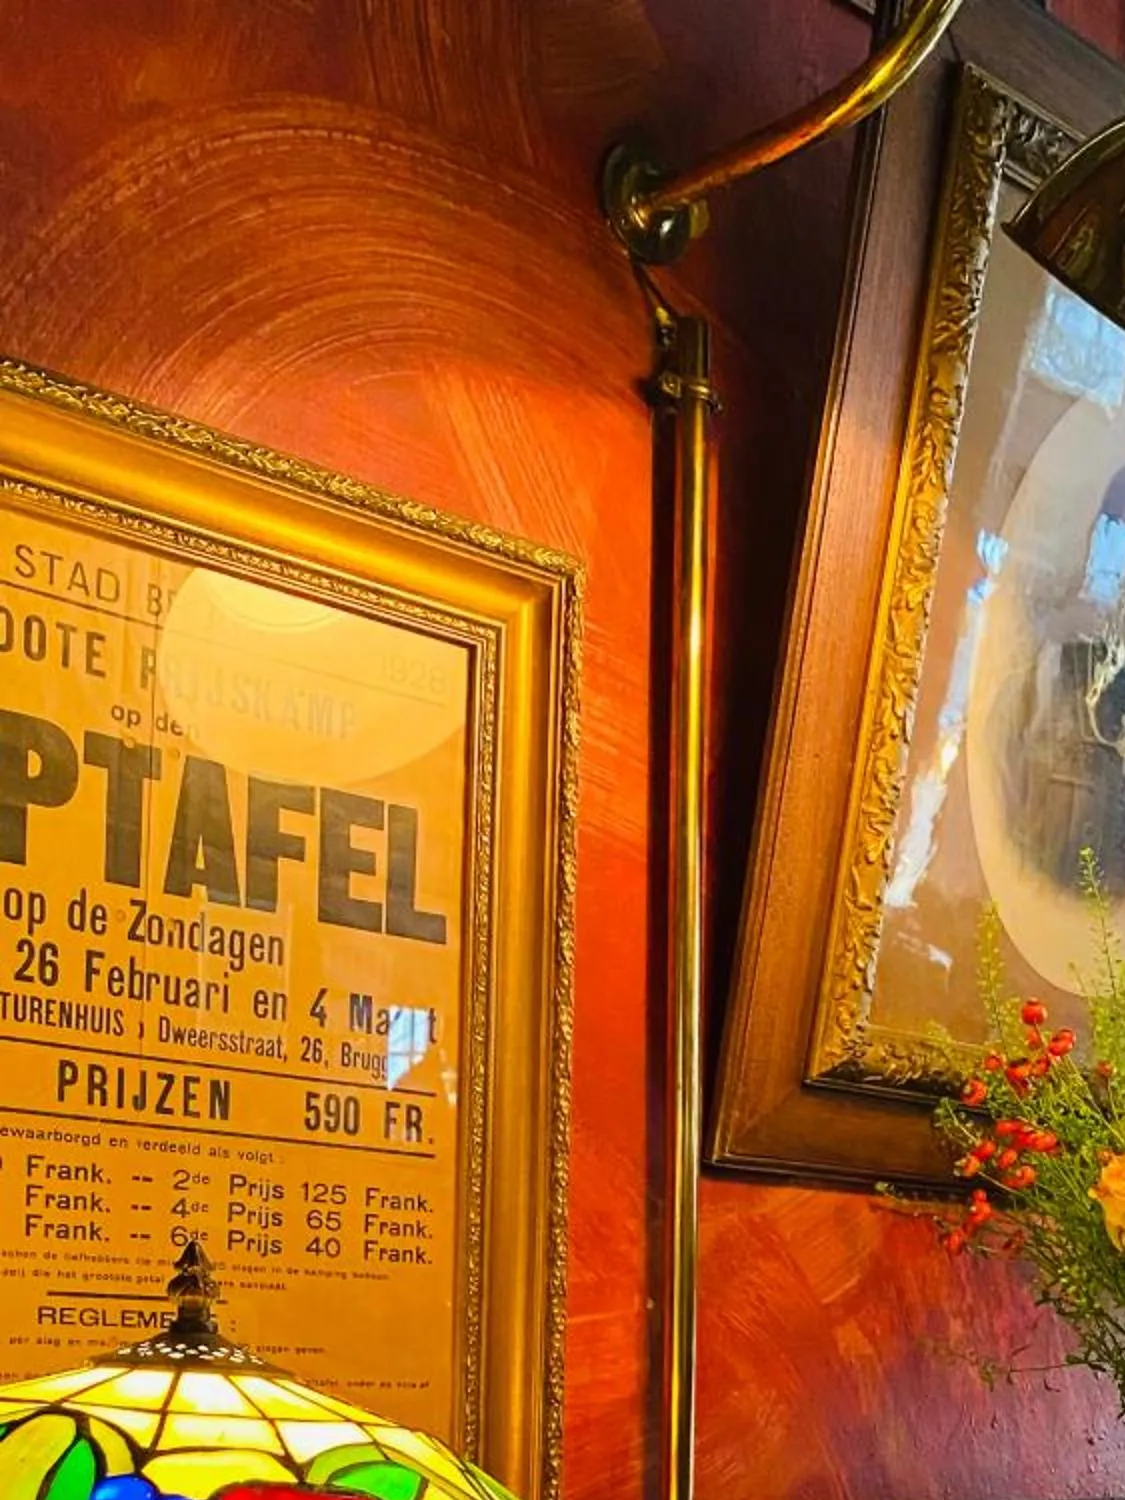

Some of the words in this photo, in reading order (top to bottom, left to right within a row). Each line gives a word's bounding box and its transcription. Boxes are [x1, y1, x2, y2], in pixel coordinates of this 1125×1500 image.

[15, 544, 120, 603] STAD
[110, 704, 141, 729] op
[0, 708, 446, 945] PTAFEL
[3, 888, 46, 936] op
[67, 888, 108, 936] de
[127, 899, 284, 972] Zondagen
[14, 938, 59, 987] 26
[84, 949, 229, 1014] Februari
[253, 988, 288, 1022] en
[309, 987, 329, 1028] 4
[349, 992, 437, 1044] Mat
[0, 991, 125, 1037] TURENHUIS
[159, 1015, 287, 1064] Dweersstraat,
[57, 1059, 231, 1121] PRIJZEN
[304, 1090, 360, 1136] 590
[384, 1100, 435, 1145] FR.
[109, 1137, 129, 1149] en
[209, 1146, 230, 1159] als
[25, 1184, 111, 1213] Frank.
[227, 1201, 283, 1229] Prijs
[306, 1209, 342, 1232] 65
[364, 1213, 433, 1239] Frank.
[26, 1154, 112, 1185] Frank.
[229, 1173, 285, 1202] Prijs
[301, 1181, 347, 1205] 125
[365, 1187, 434, 1213] Frank.
[25, 1213, 110, 1243] Frank.
[227, 1230, 282, 1257] Prijs
[305, 1236, 341, 1259] 40
[363, 1239, 433, 1265] Frank.
[37, 1305, 217, 1330] REGLEME
